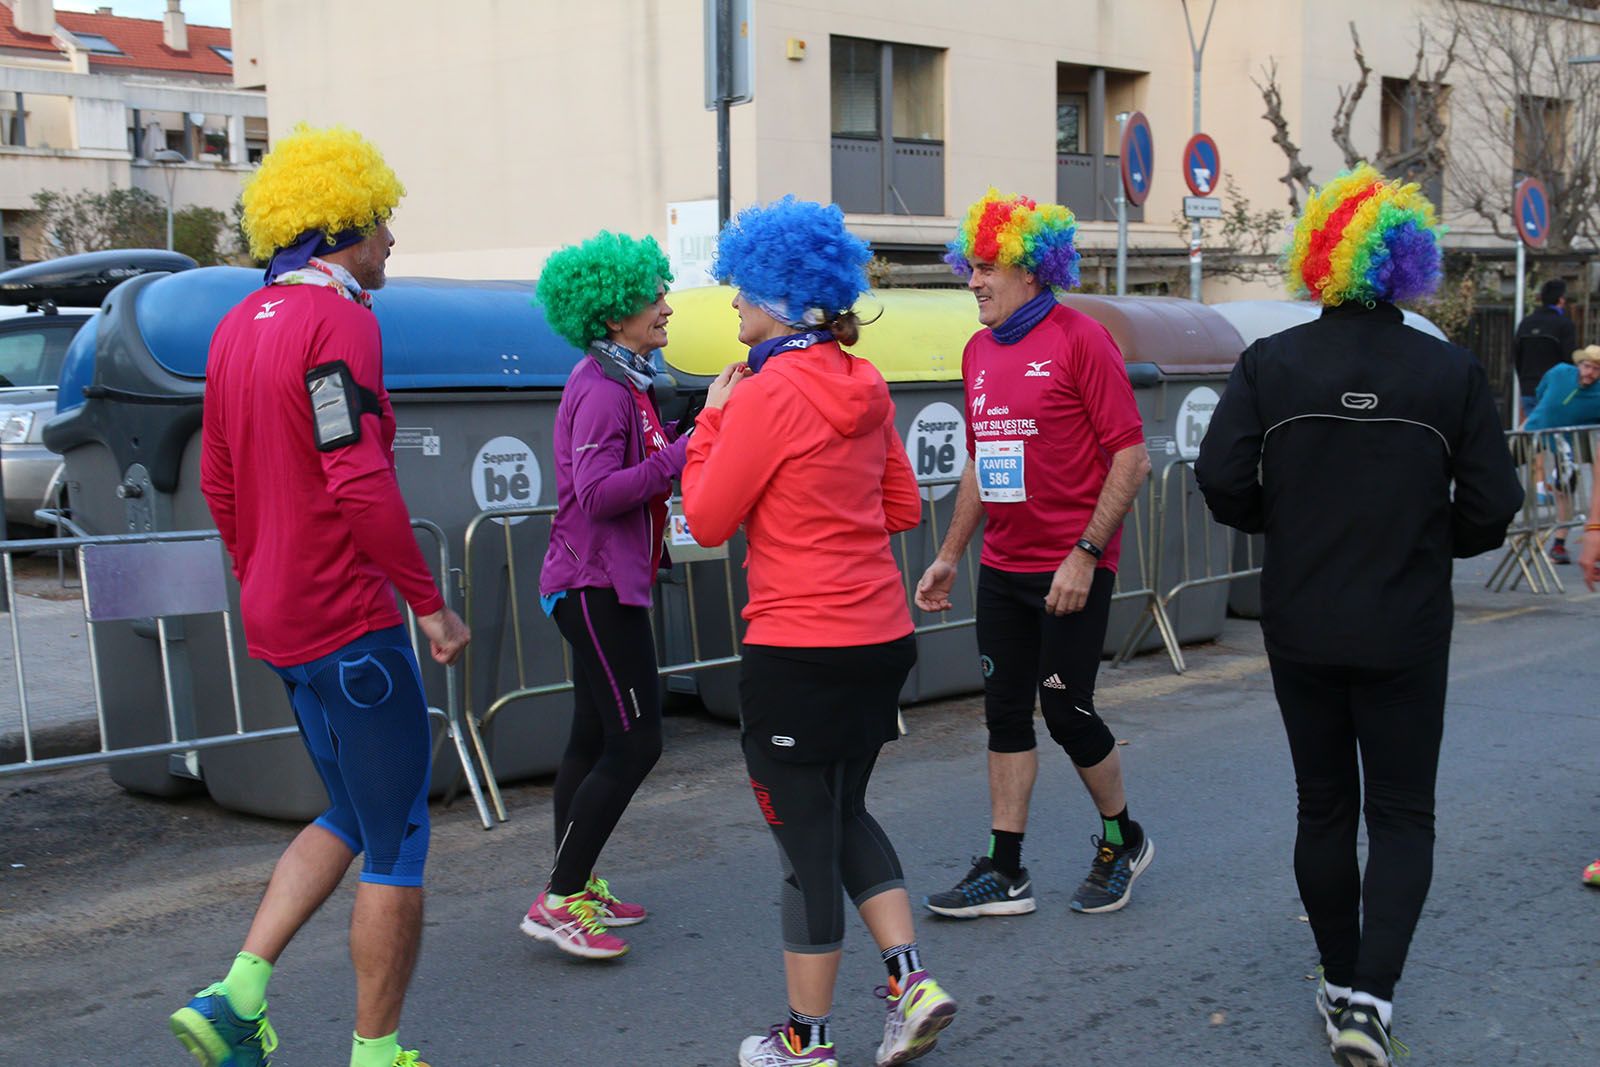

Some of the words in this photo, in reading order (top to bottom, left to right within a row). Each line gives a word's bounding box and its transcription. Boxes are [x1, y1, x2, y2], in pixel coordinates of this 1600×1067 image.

[971, 393, 986, 416] 19
[986, 405, 1009, 416] edició
[917, 419, 958, 434] Separar
[972, 420, 989, 431] SANT
[989, 418, 1036, 430] SILVESTRE
[482, 452, 528, 466] Separar
[917, 434, 955, 476] bé
[982, 458, 1017, 470] XAVIER
[484, 463, 530, 502] bé
[989, 472, 1010, 486] 586
